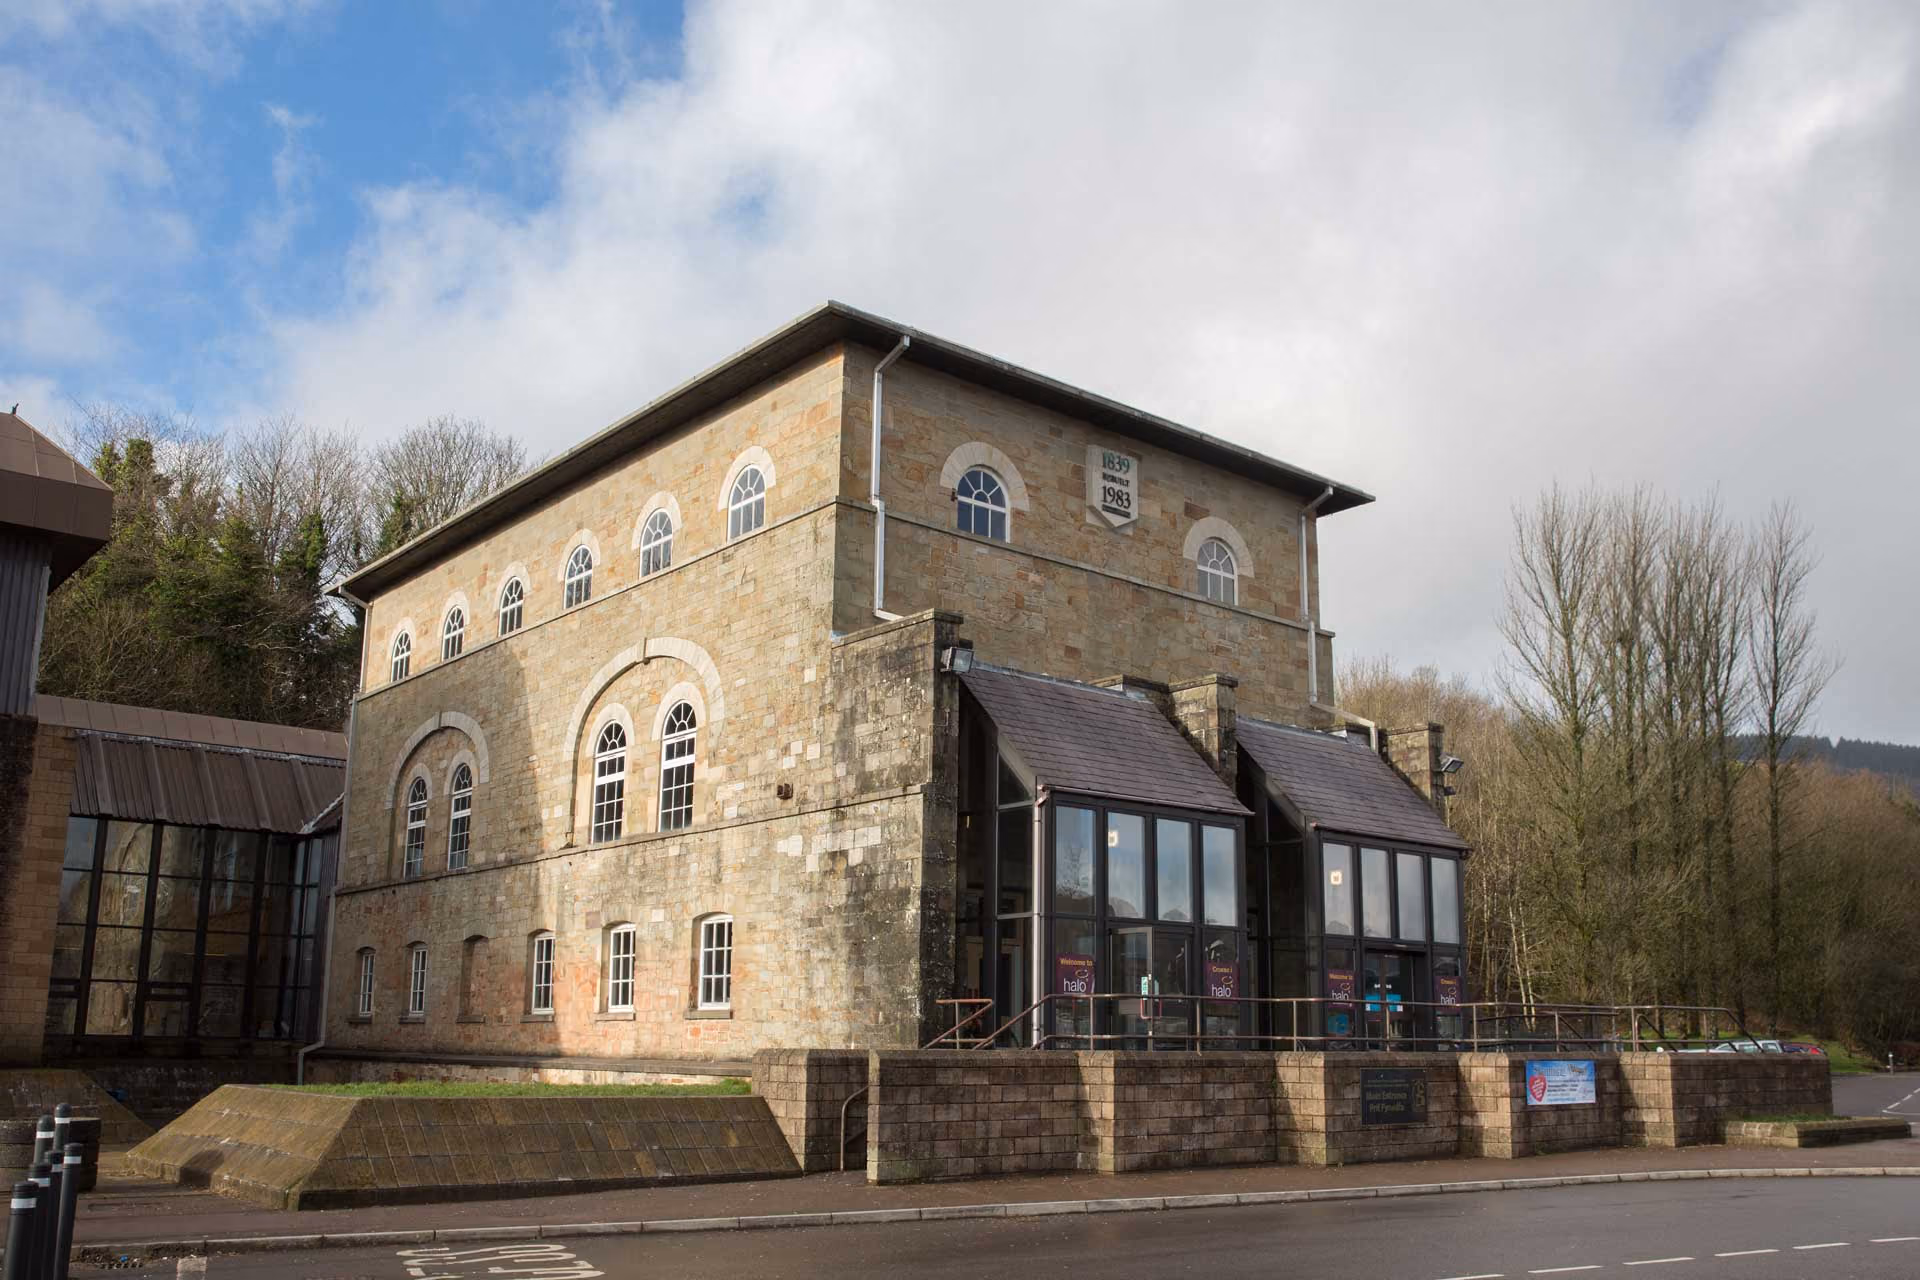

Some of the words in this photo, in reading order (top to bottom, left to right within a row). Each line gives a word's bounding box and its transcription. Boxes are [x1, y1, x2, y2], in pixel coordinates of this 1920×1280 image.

[1103, 452, 1130, 474] 1839
[1102, 485, 1132, 509] 1983
[1060, 957, 1085, 966] Welcome
[1063, 978, 1087, 992] halo
[1211, 984, 1232, 998] halo
